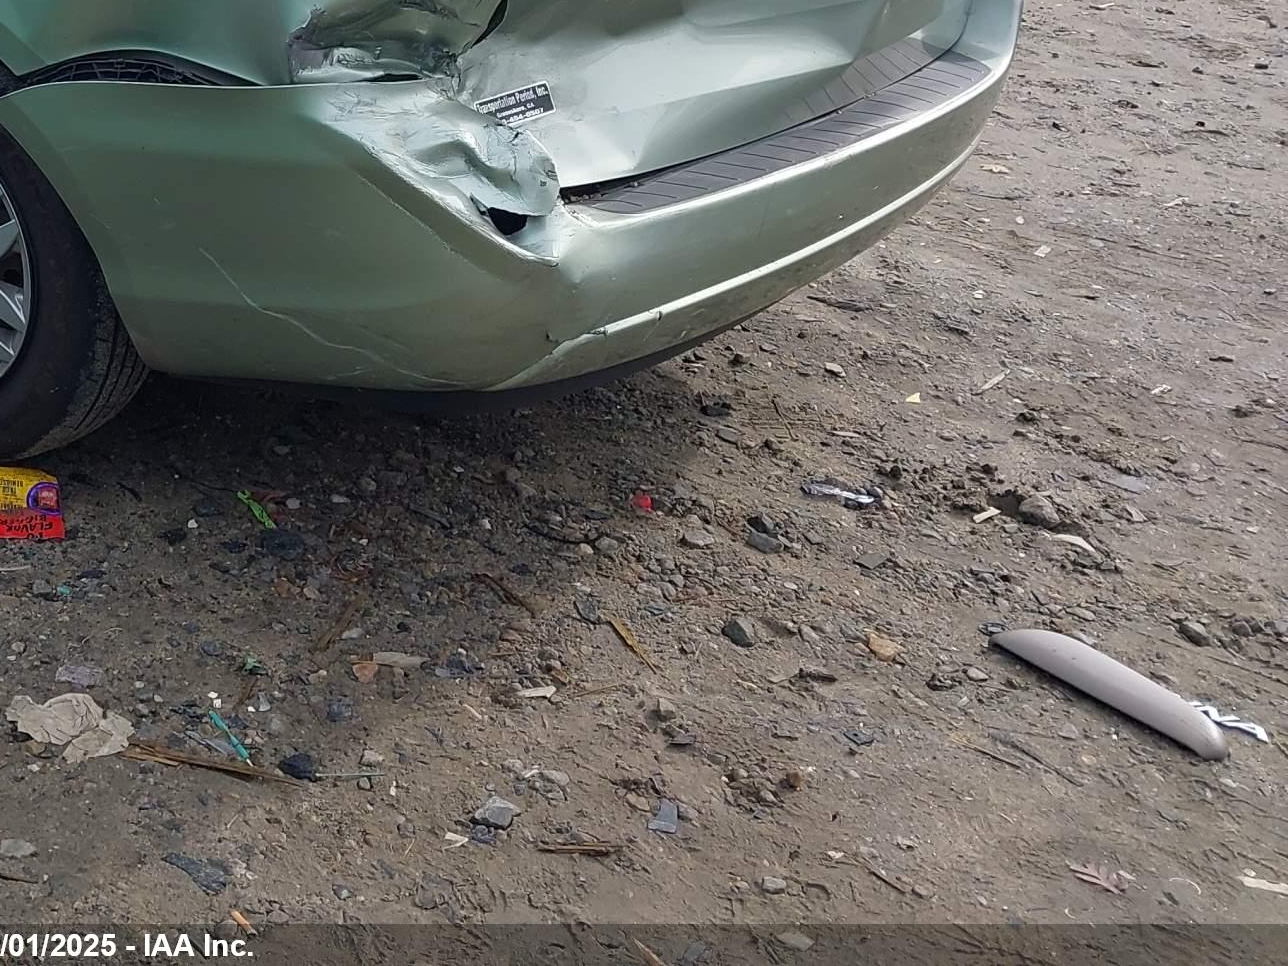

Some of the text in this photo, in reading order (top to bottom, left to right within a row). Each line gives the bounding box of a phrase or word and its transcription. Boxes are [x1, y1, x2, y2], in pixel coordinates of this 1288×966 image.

[477, 95, 517, 115] Transportation
[535, 85, 549, 97] Inc.
[6, 521, 54, 533] FLAVOR
